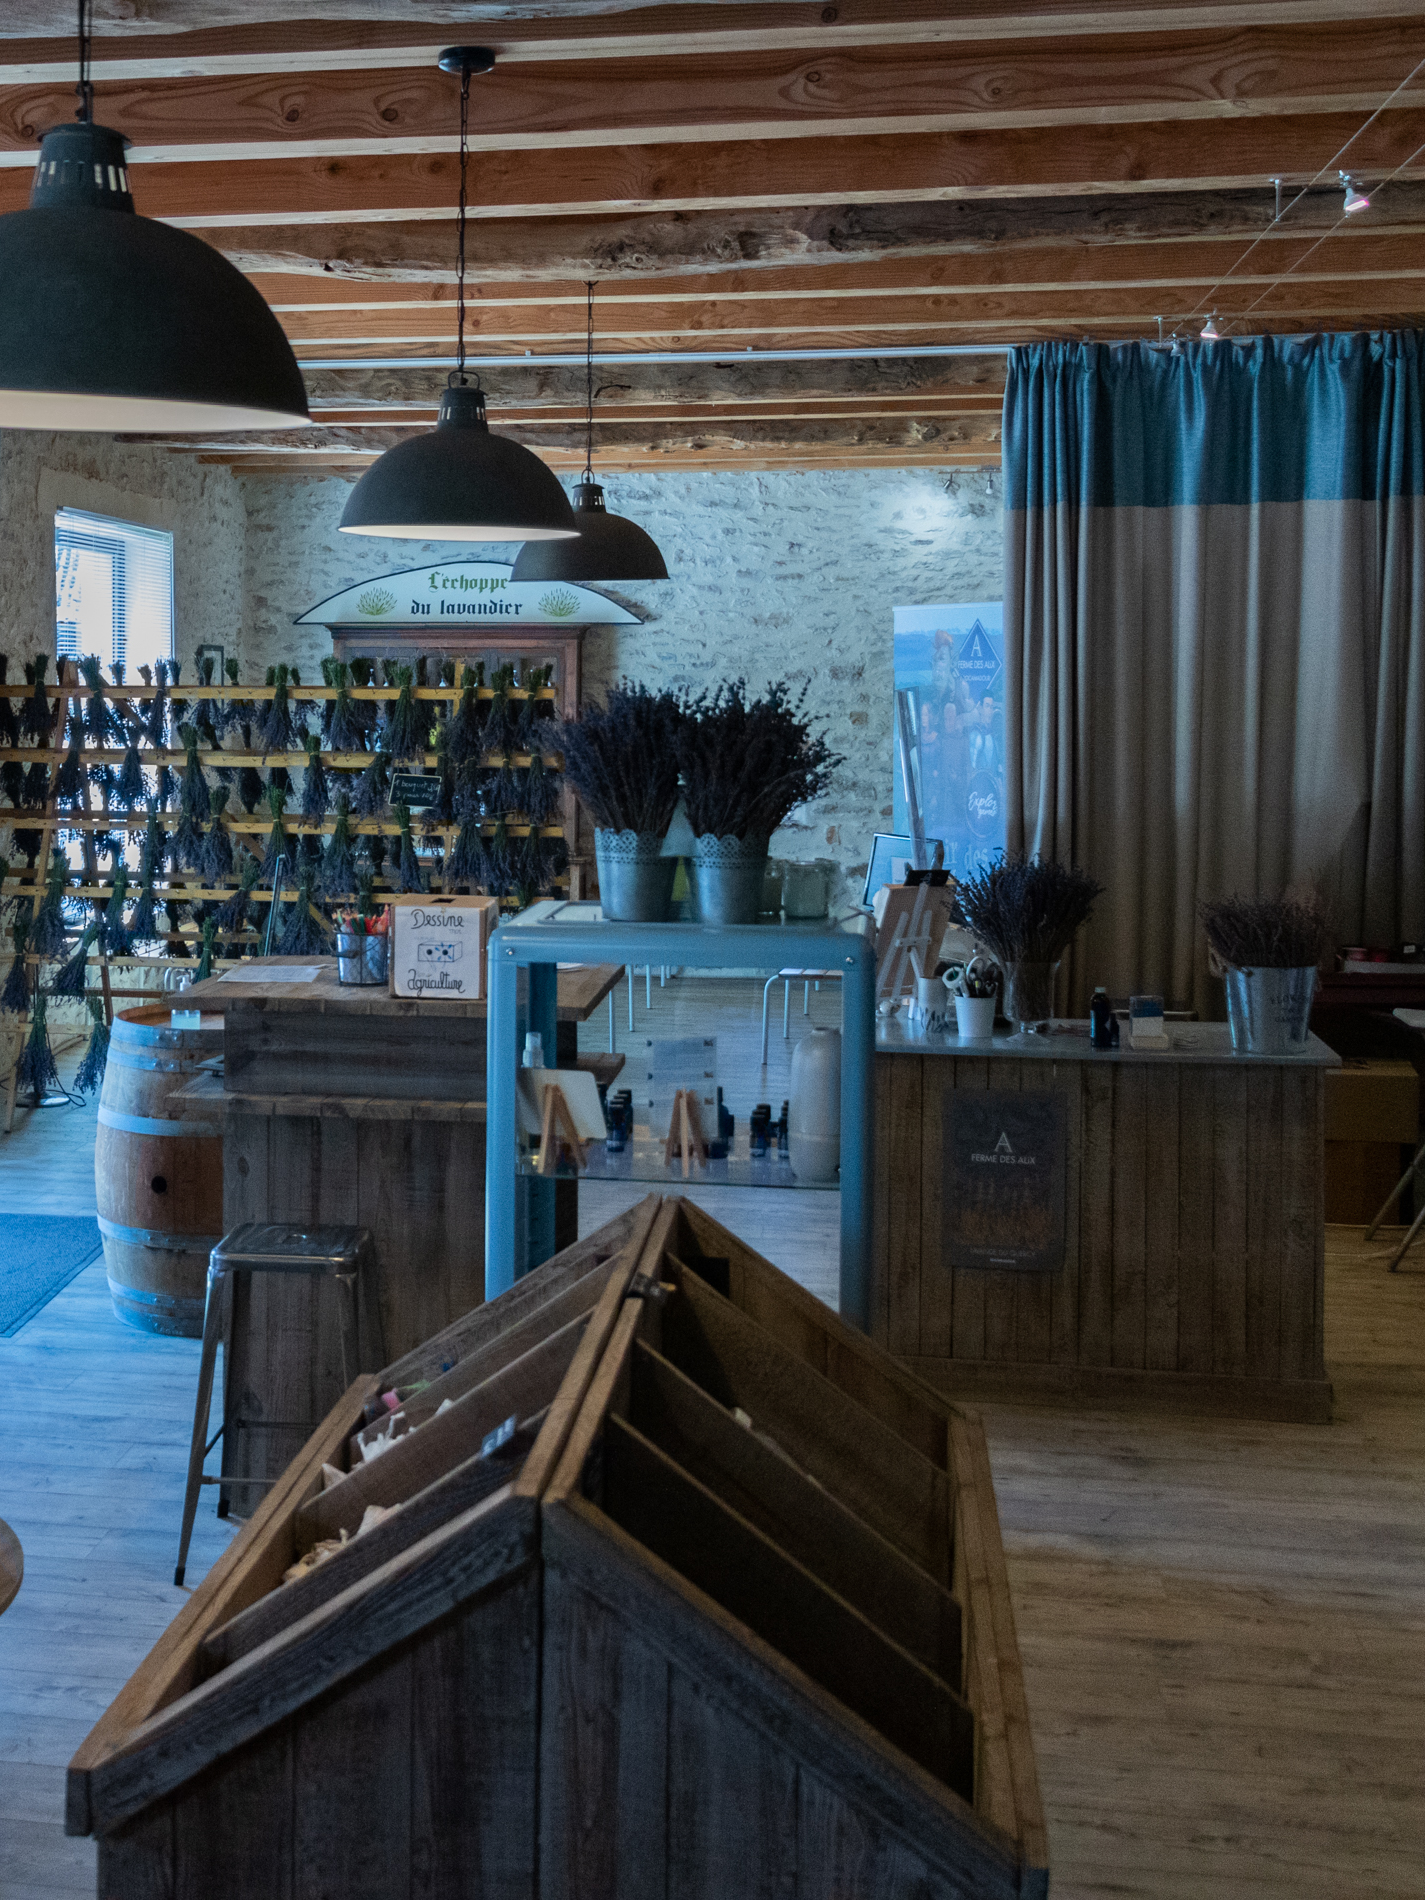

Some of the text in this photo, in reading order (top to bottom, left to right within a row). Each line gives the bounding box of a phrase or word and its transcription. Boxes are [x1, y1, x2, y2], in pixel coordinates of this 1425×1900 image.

[410, 599, 523, 616] du lavandier
[970, 635, 982, 657] A
[974, 660, 983, 669] DES
[411, 909, 464, 929] Dessine
[994, 1131, 1013, 1153] A
[971, 1153, 997, 1163] FERME
[999, 1155, 1016, 1164] DES
